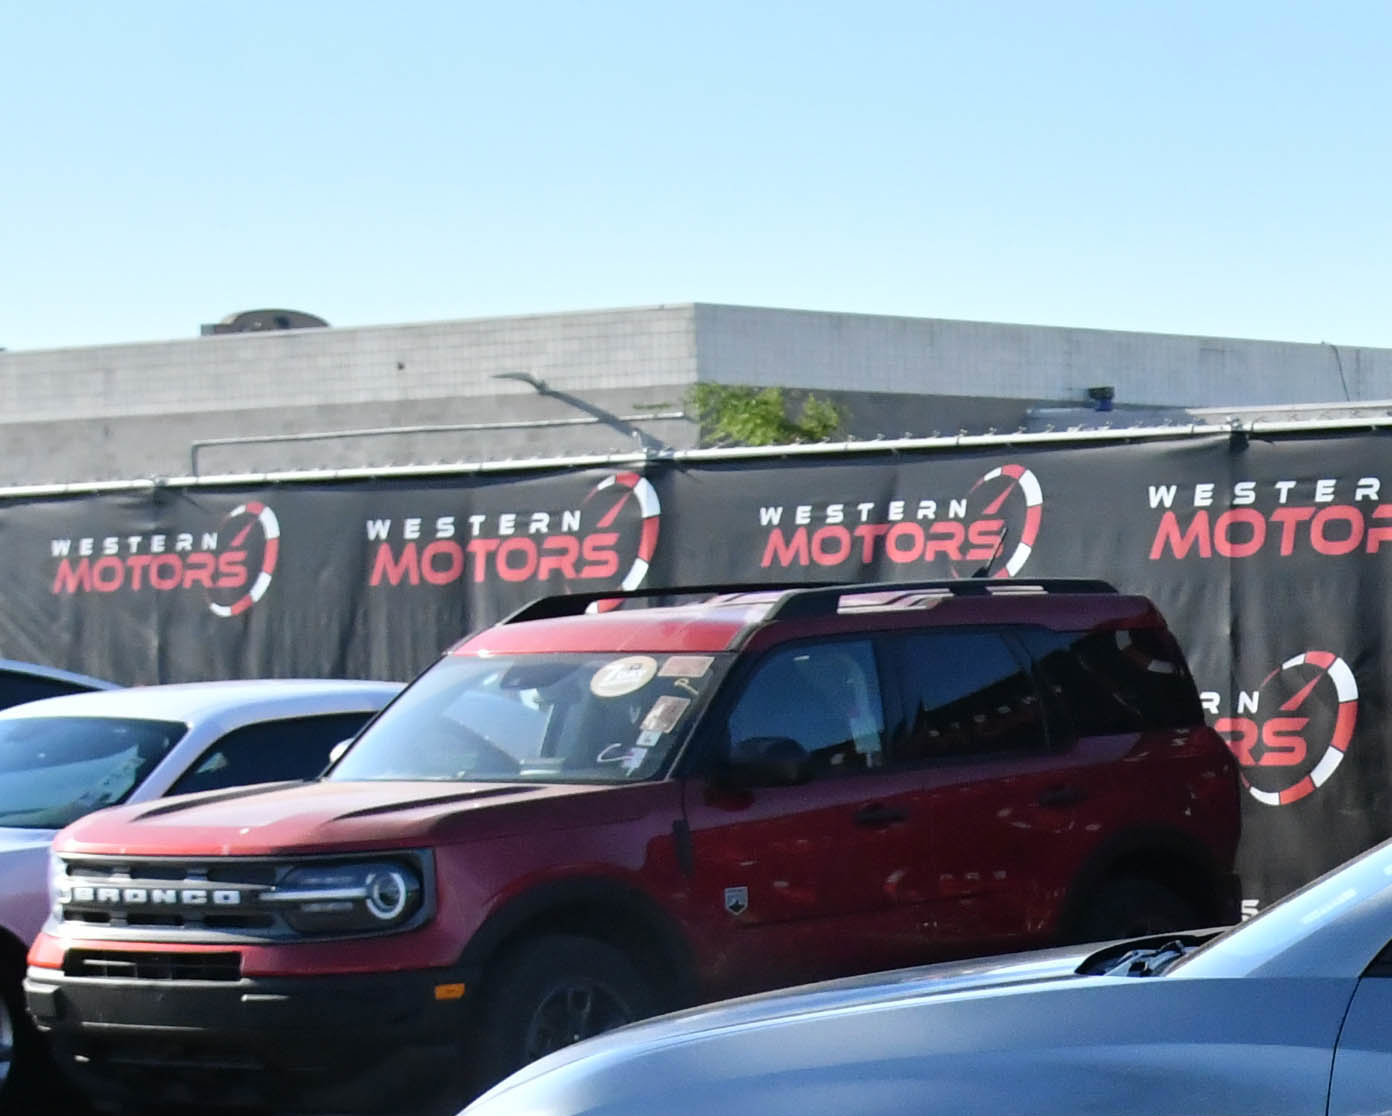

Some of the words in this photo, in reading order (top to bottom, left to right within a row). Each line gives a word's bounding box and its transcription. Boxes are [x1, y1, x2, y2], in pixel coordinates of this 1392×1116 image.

[366, 509, 582, 541] WESTERN
[759, 498, 969, 527] WESTERN
[50, 532, 219, 558] WESTERN
[368, 531, 620, 586] MOTORS
[760, 519, 1004, 567] MOTORS
[52, 549, 249, 594] MOTORS
[73, 886, 241, 905] BRONCO
